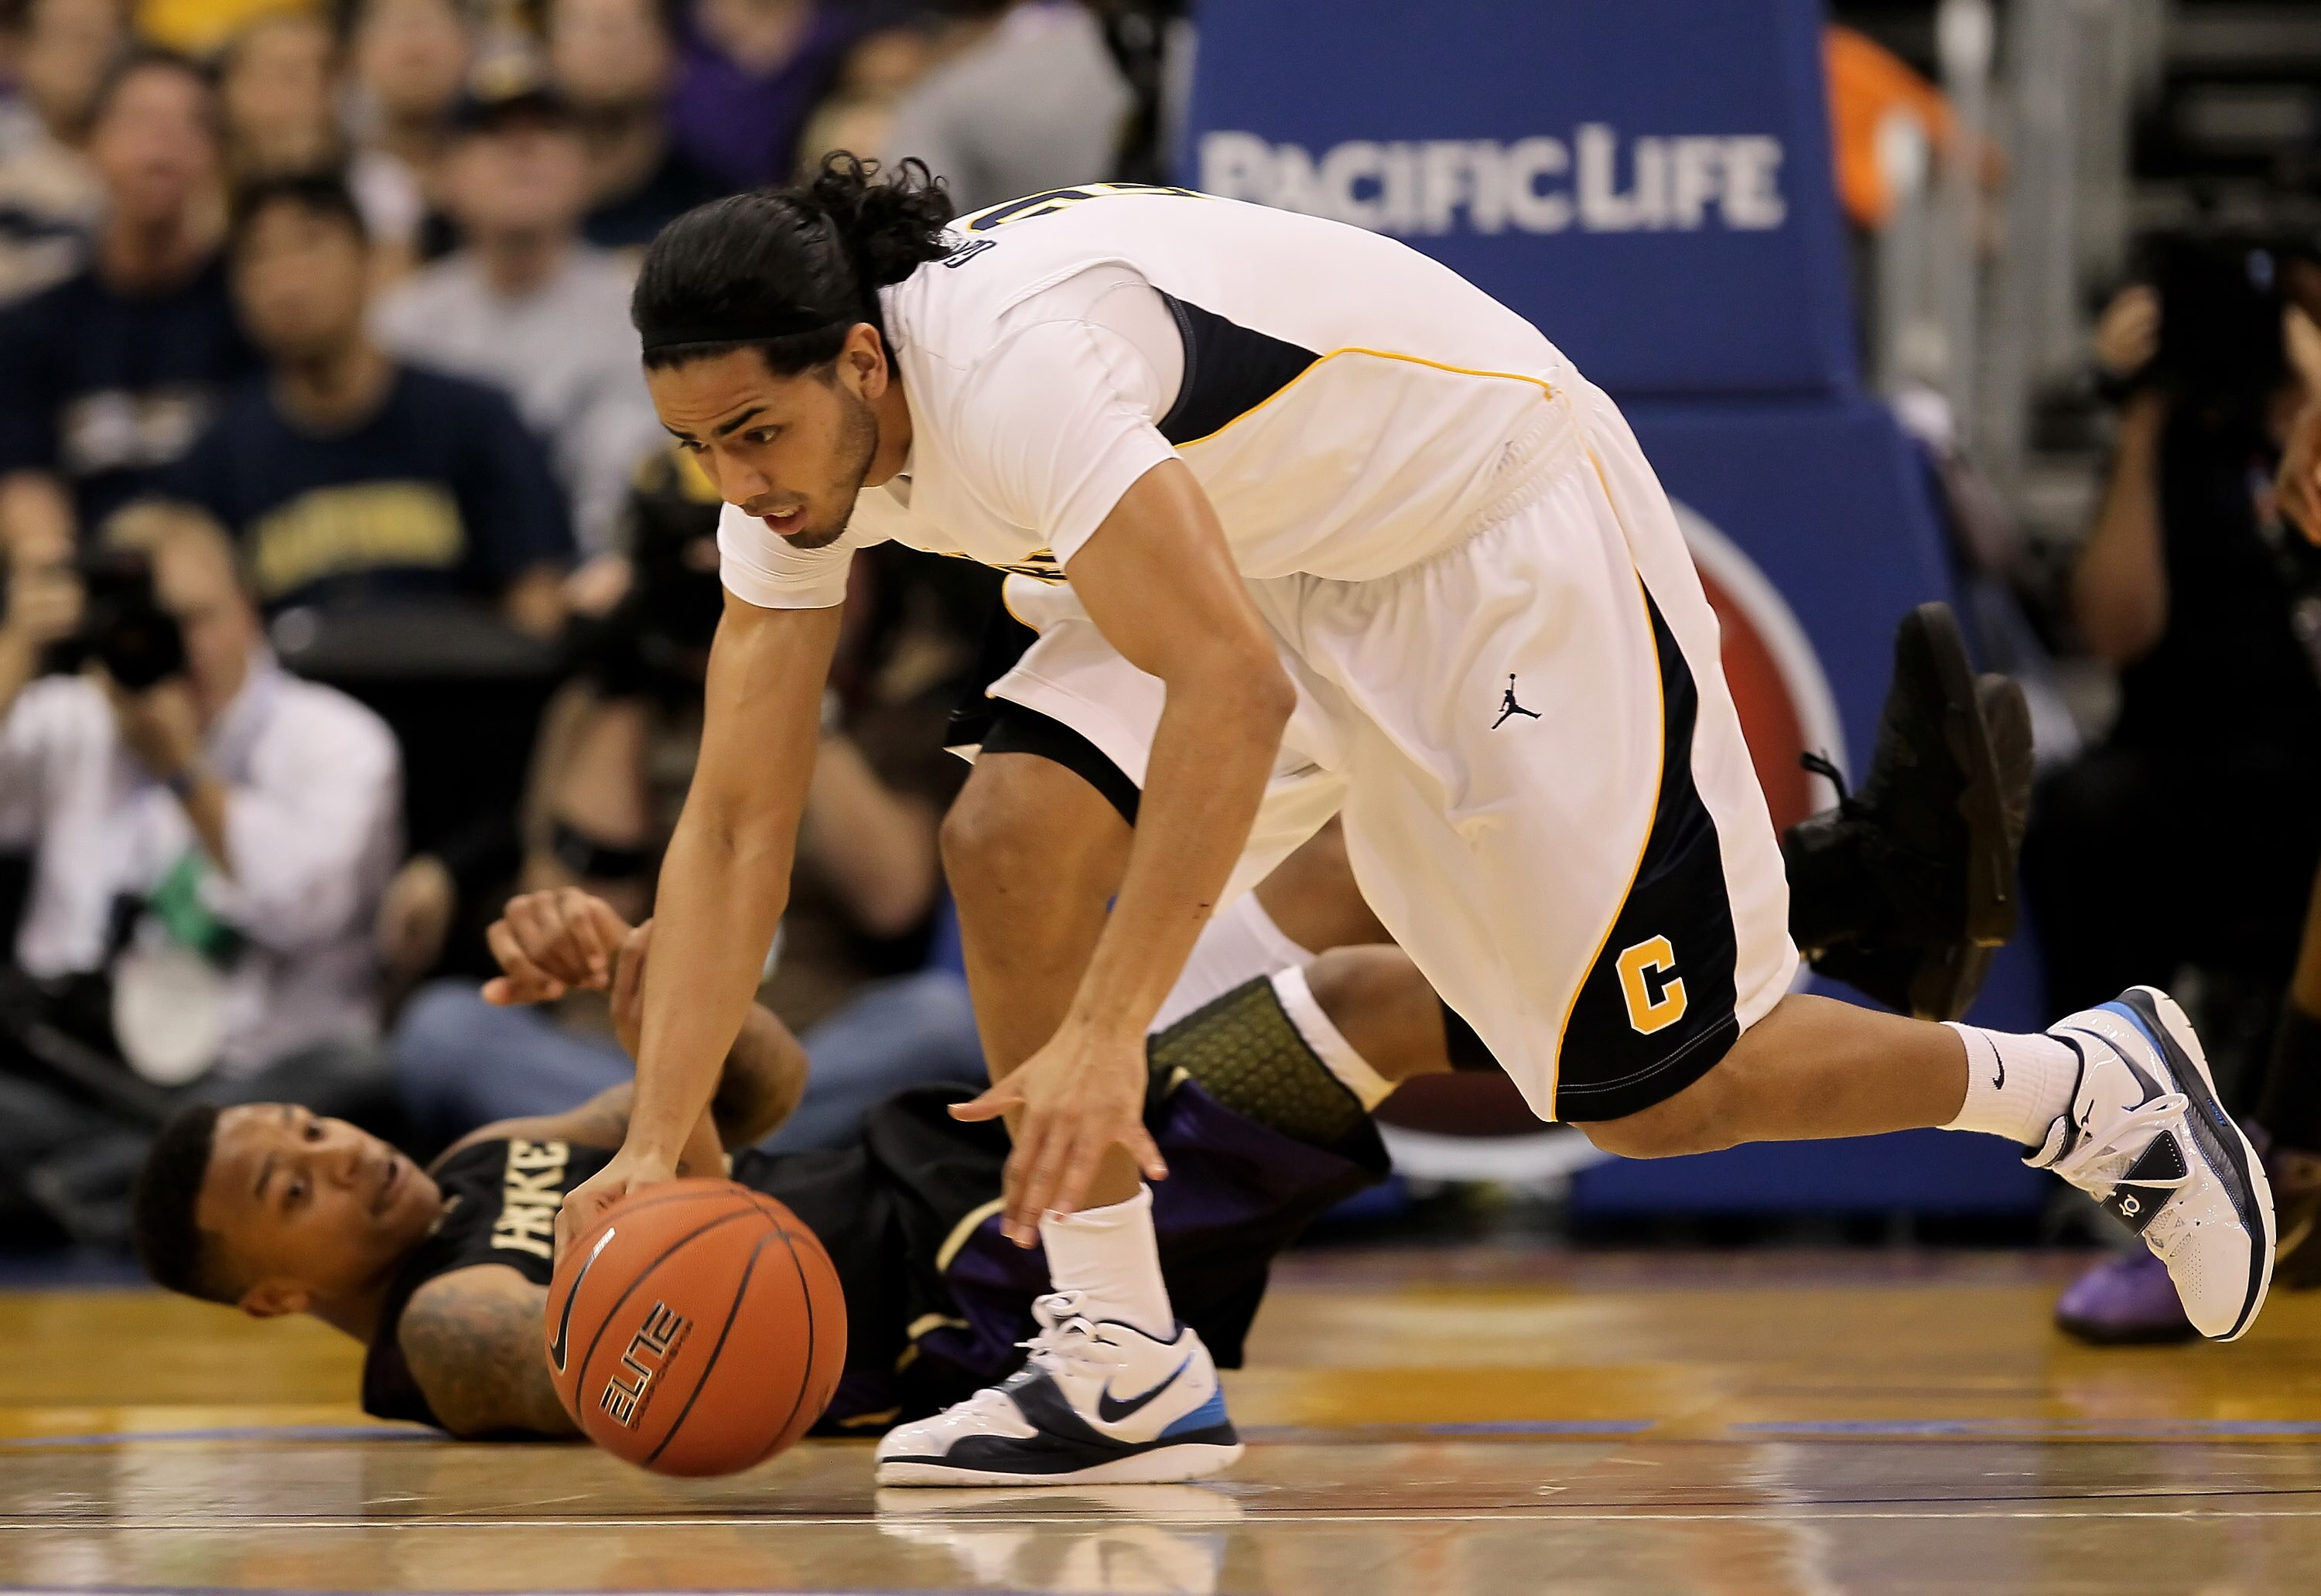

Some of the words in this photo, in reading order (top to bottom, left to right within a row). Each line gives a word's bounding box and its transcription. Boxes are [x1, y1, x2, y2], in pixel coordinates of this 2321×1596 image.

[1201, 128, 1571, 235] PACIFIC
[1575, 120, 1787, 233] LIFE
[1615, 934, 1688, 1036] C
[600, 1299, 685, 1428] ELITE
